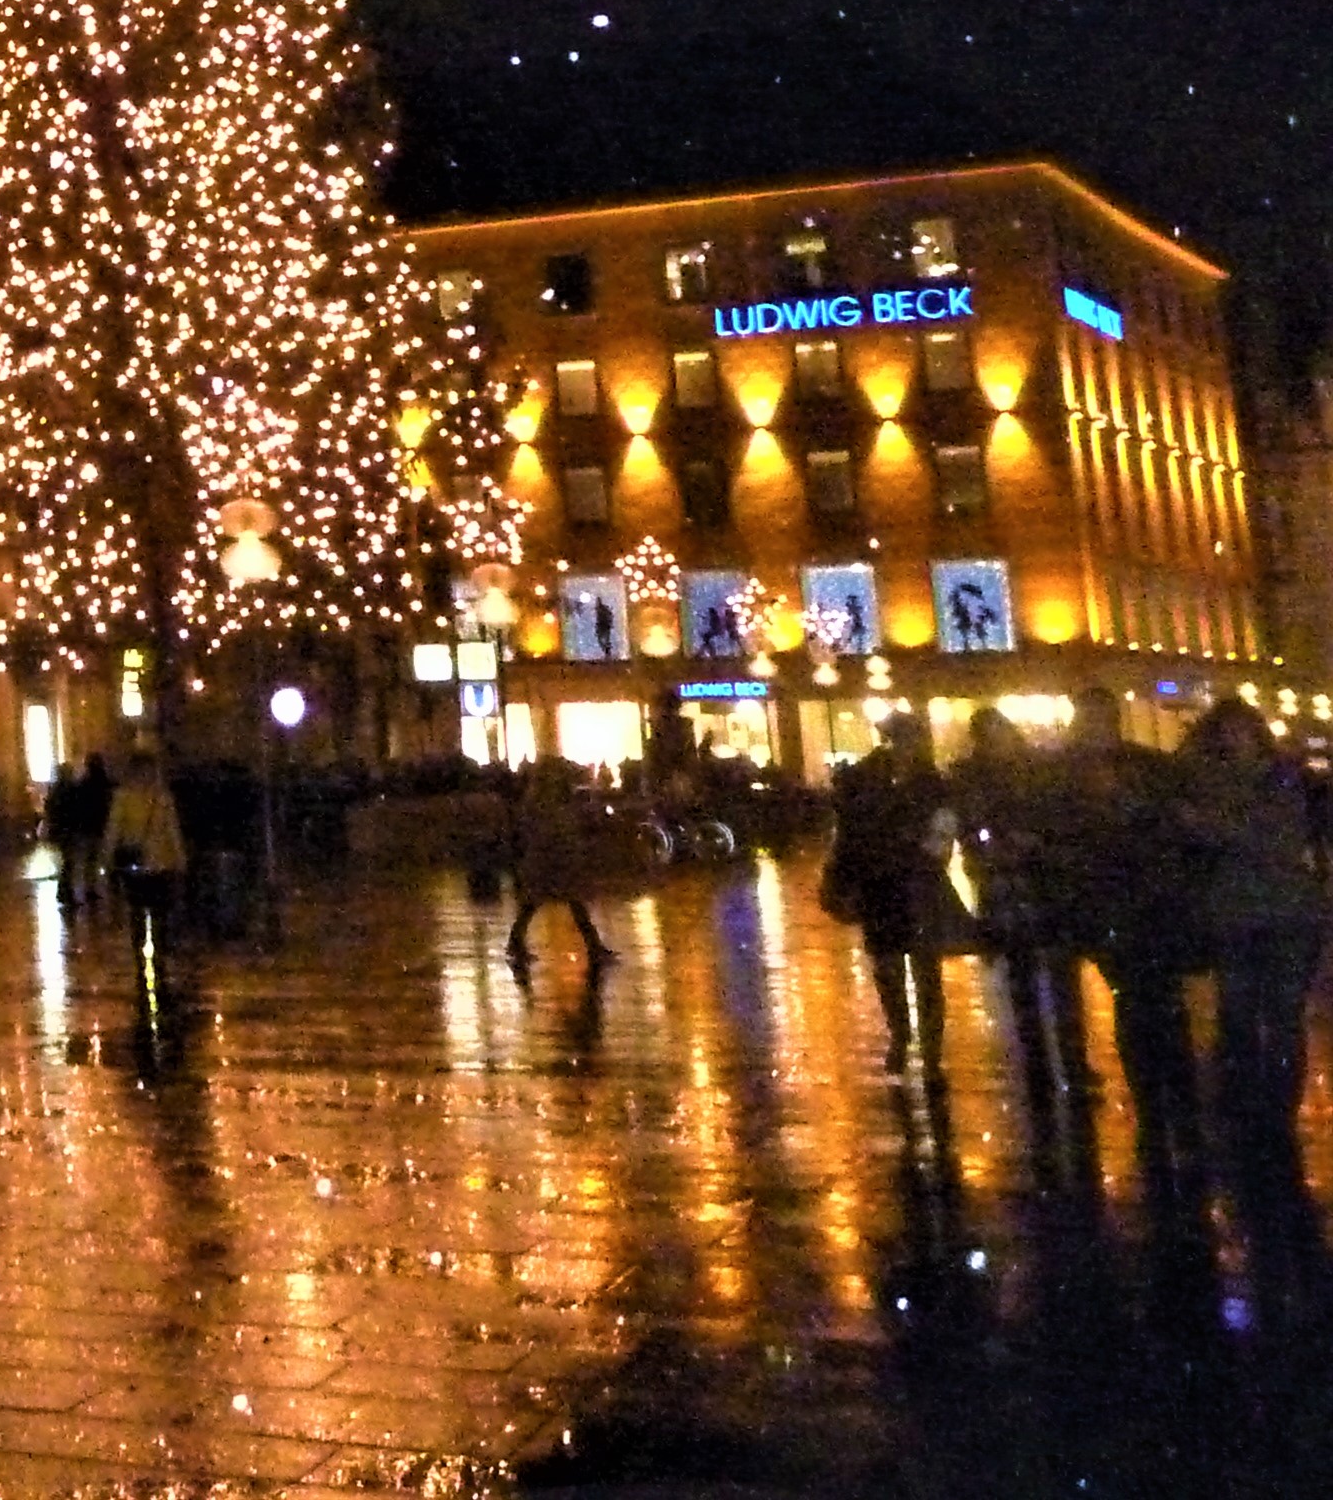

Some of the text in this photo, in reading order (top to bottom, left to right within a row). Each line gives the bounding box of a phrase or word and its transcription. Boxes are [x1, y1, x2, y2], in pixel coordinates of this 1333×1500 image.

[715, 286, 973, 336] LUDWIG BECK
[463, 684, 494, 717] U
